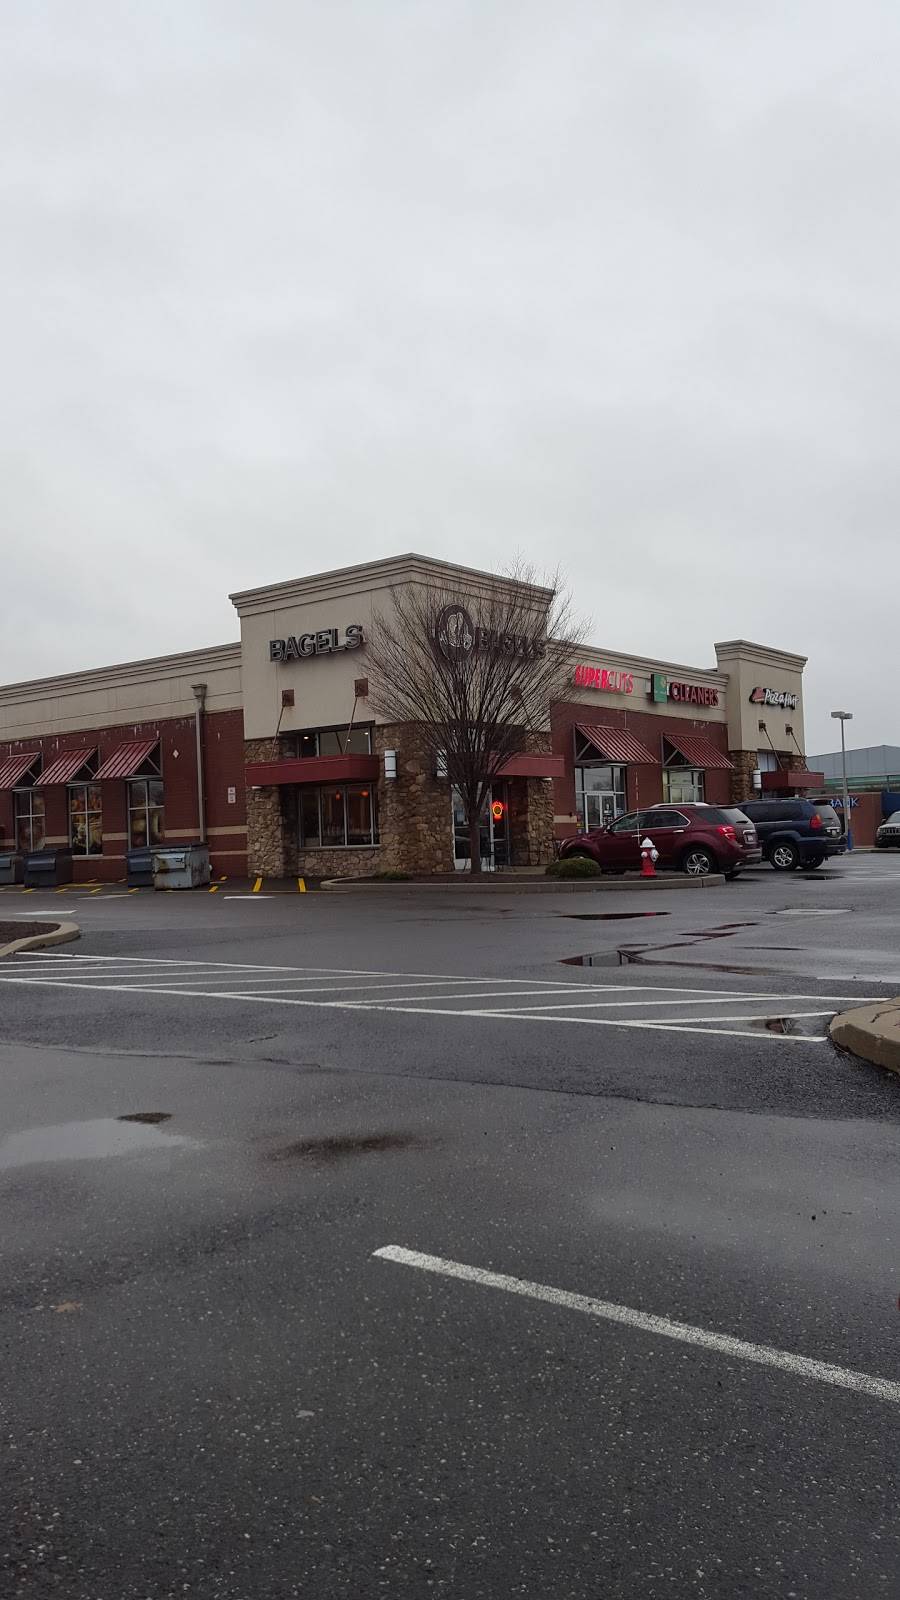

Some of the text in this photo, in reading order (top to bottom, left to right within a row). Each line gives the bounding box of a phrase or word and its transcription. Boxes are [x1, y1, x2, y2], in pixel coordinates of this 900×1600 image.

[269, 624, 363, 662] BAGELS
[575, 664, 633, 693] SUPERCUTS
[671, 682, 719, 706] CLEANERS
